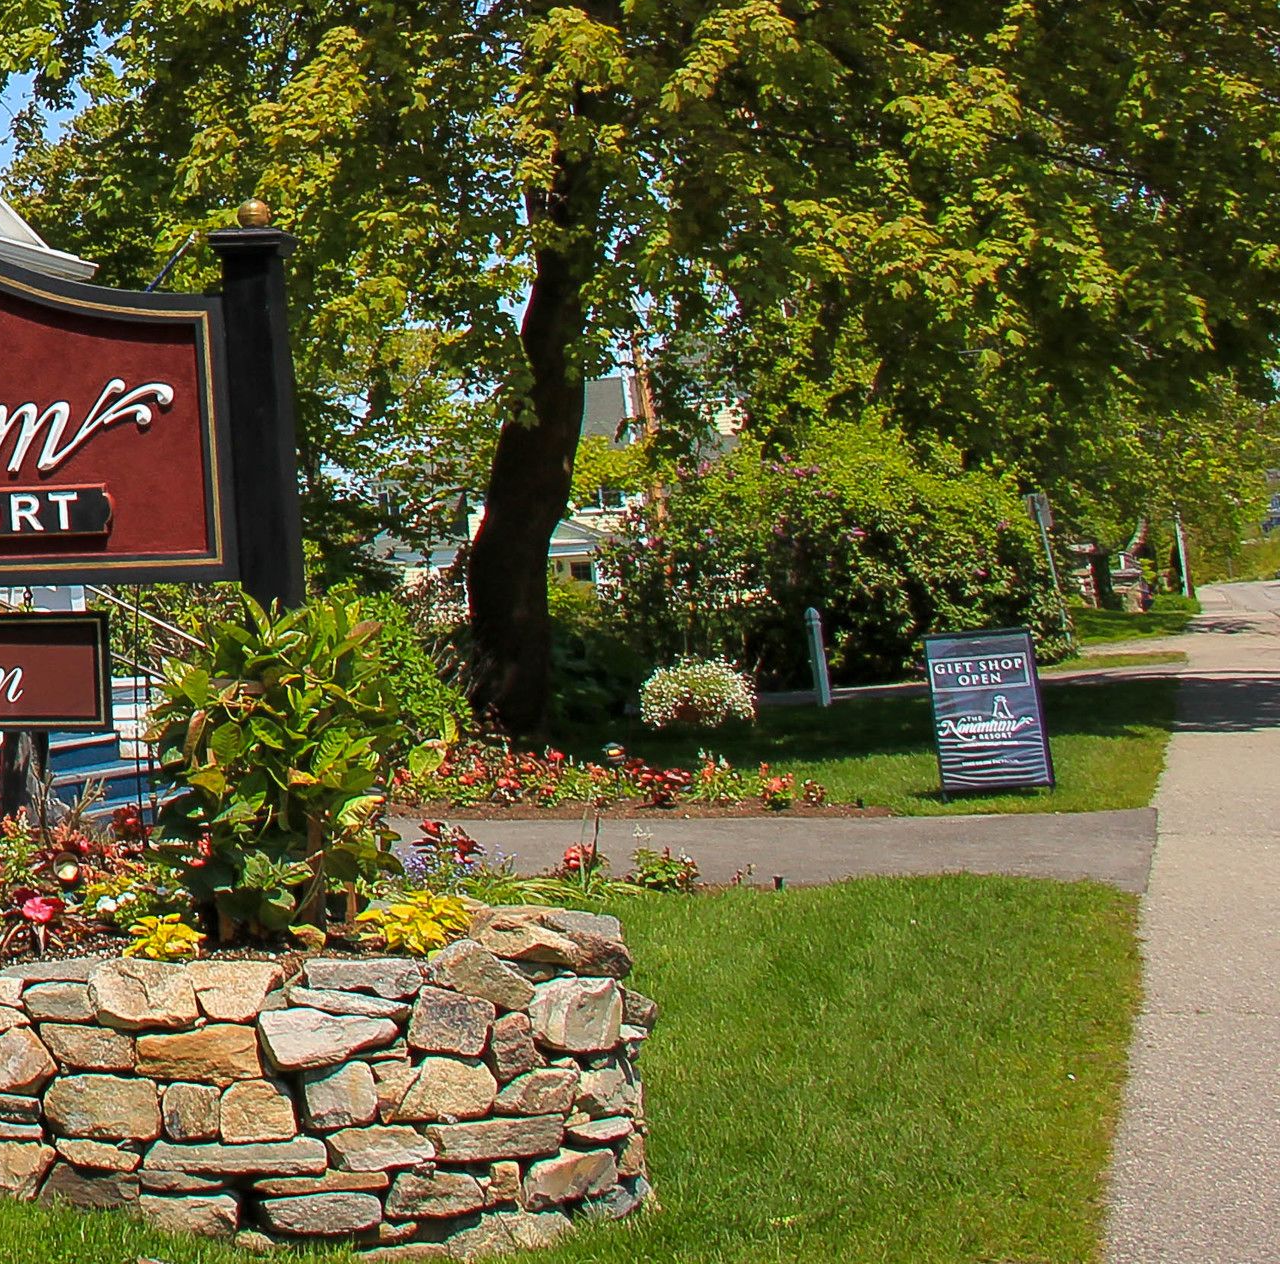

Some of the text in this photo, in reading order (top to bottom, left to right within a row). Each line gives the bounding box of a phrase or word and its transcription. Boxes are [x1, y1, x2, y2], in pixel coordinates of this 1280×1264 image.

[934, 657, 1023, 675] GIFT SHOP
[958, 672, 1002, 686] OPEN
